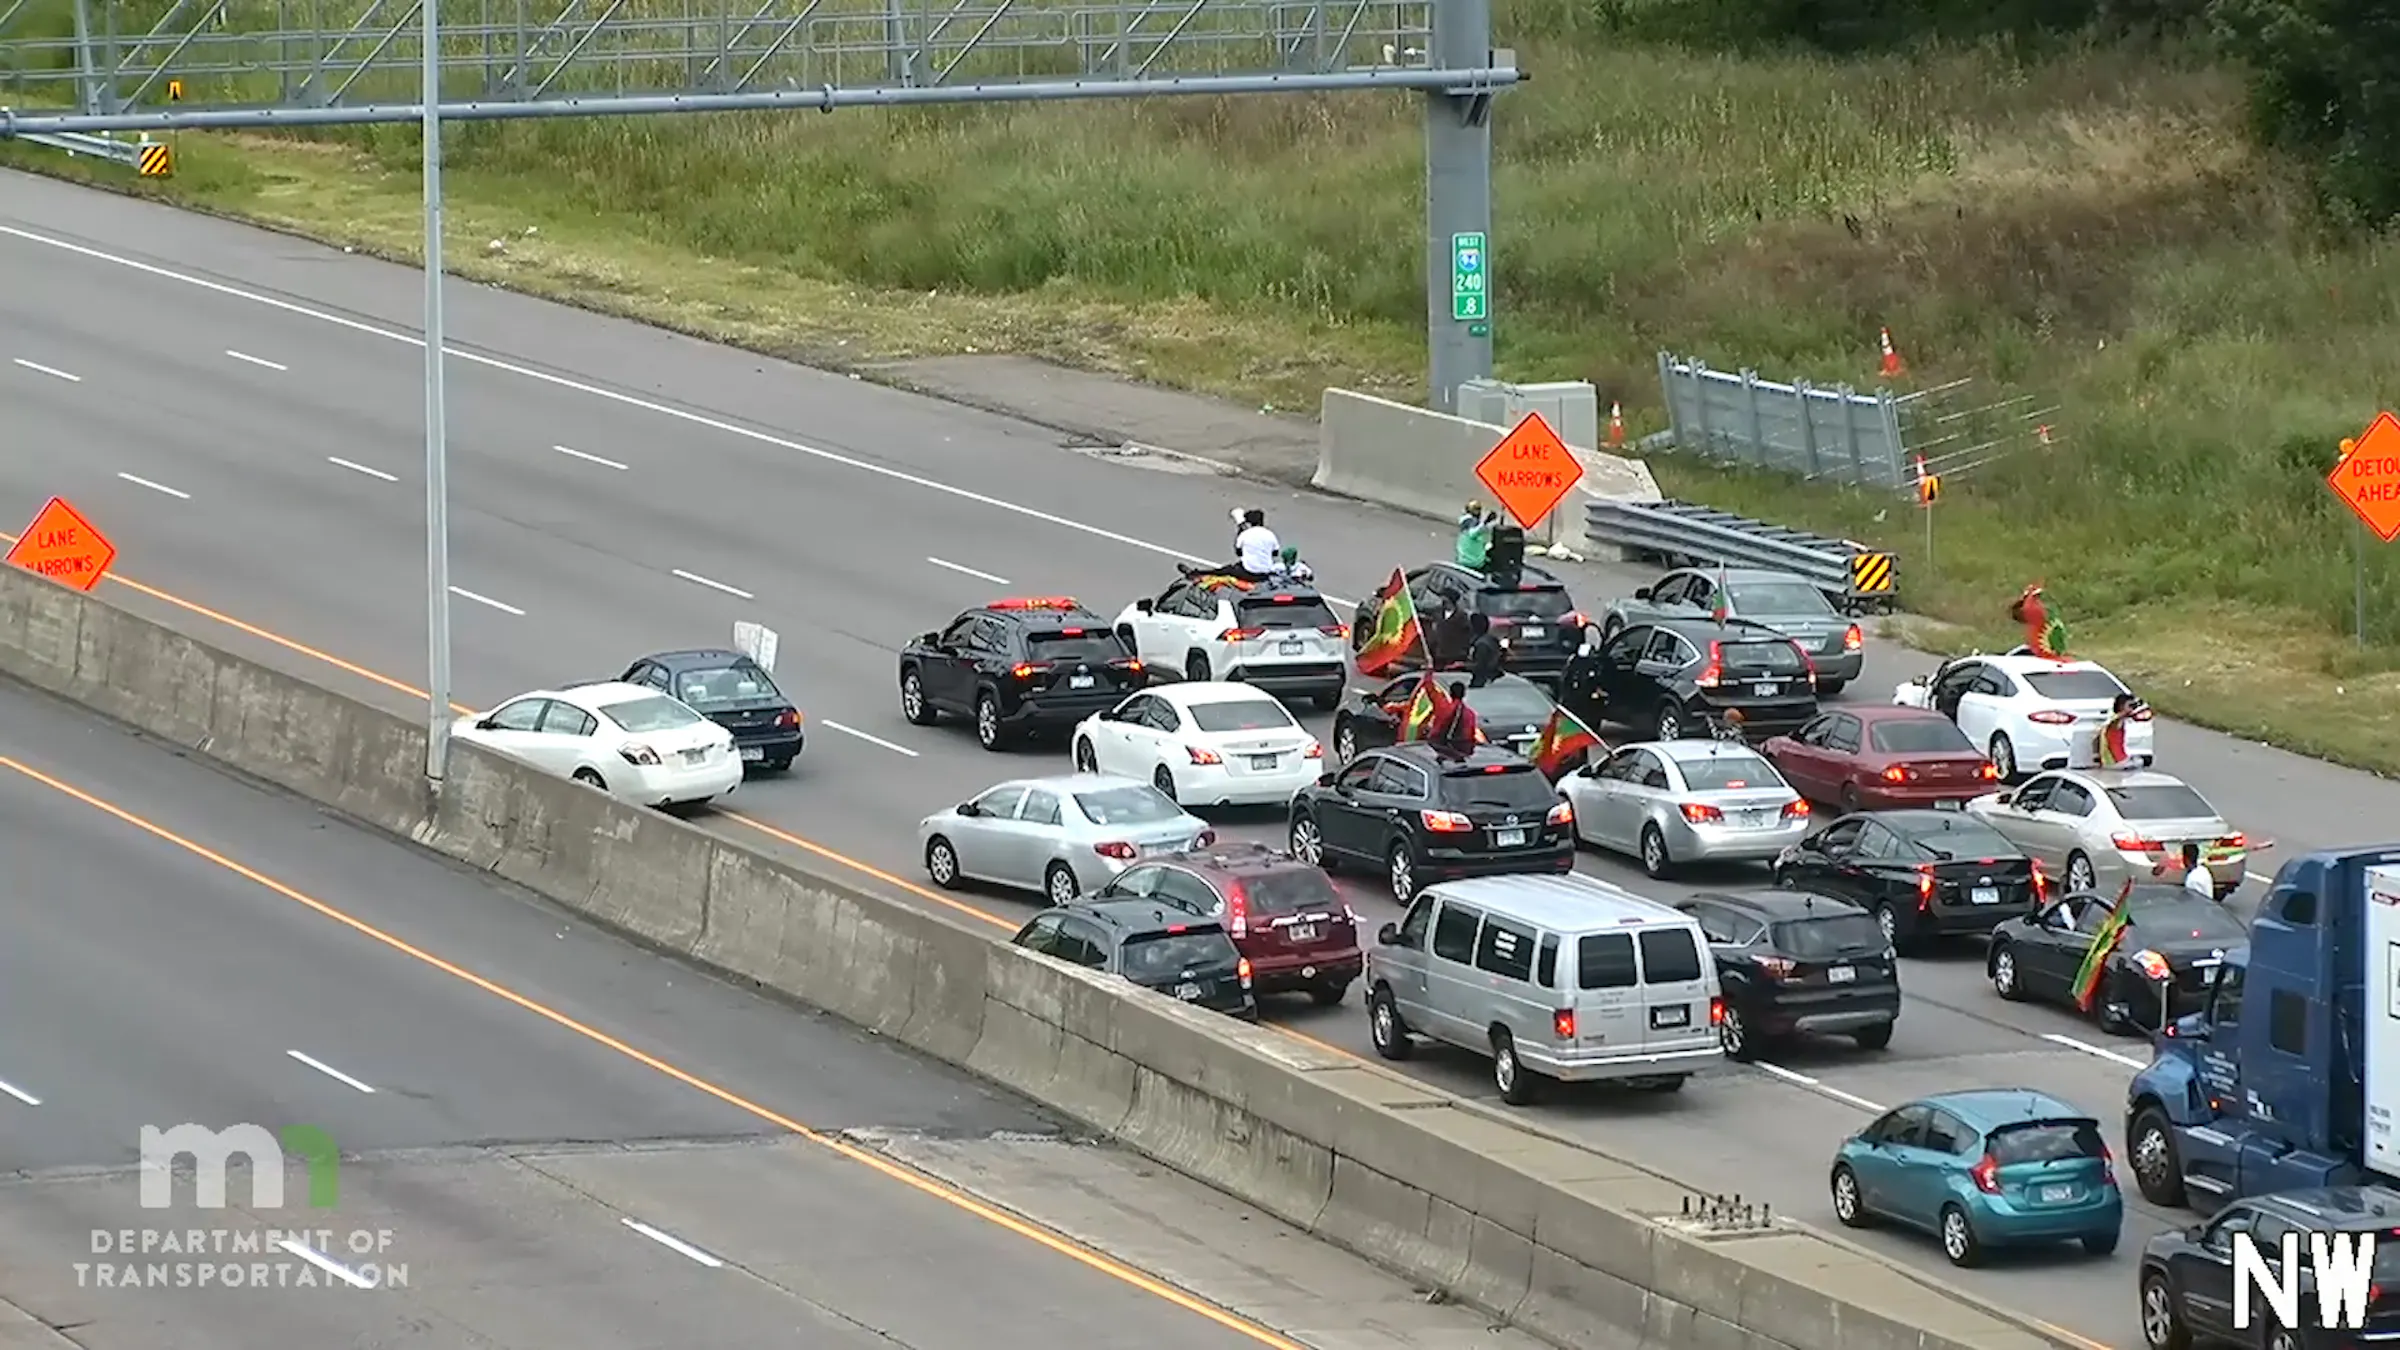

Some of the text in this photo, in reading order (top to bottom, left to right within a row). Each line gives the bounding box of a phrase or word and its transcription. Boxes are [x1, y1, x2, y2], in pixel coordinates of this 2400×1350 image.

[1457, 237, 1479, 246] WEST
[1456, 273, 1482, 291] 240
[1513, 444, 1551, 460] LANE
[1498, 470, 1562, 488] NARROWS
[37, 528, 77, 549] LANE
